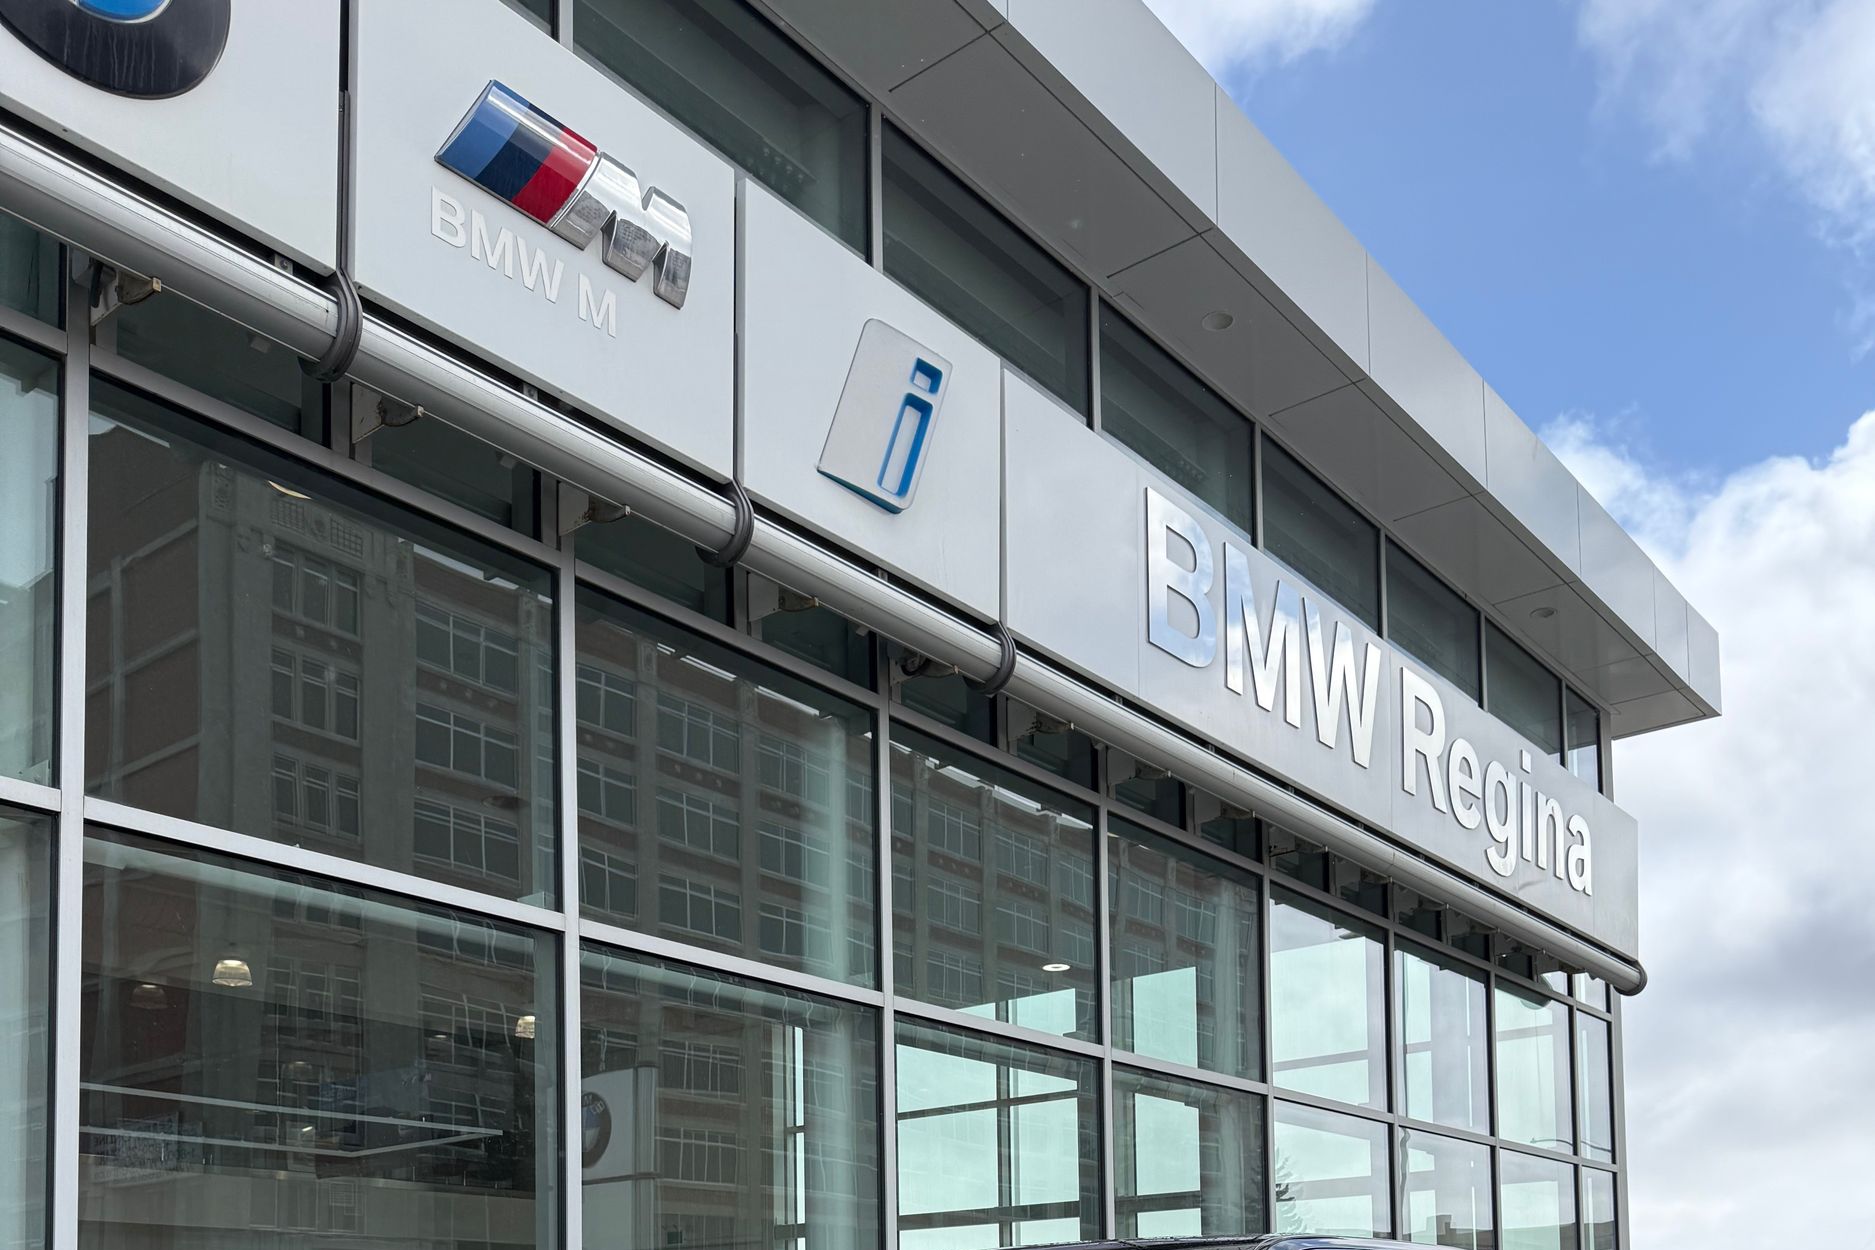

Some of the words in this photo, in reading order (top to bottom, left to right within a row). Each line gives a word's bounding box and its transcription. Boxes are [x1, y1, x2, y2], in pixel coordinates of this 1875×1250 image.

[431, 185, 564, 304] BMW
[578, 272, 617, 338] M
[1146, 486, 1381, 769] BMW
[1401, 666, 1591, 896] Regina
